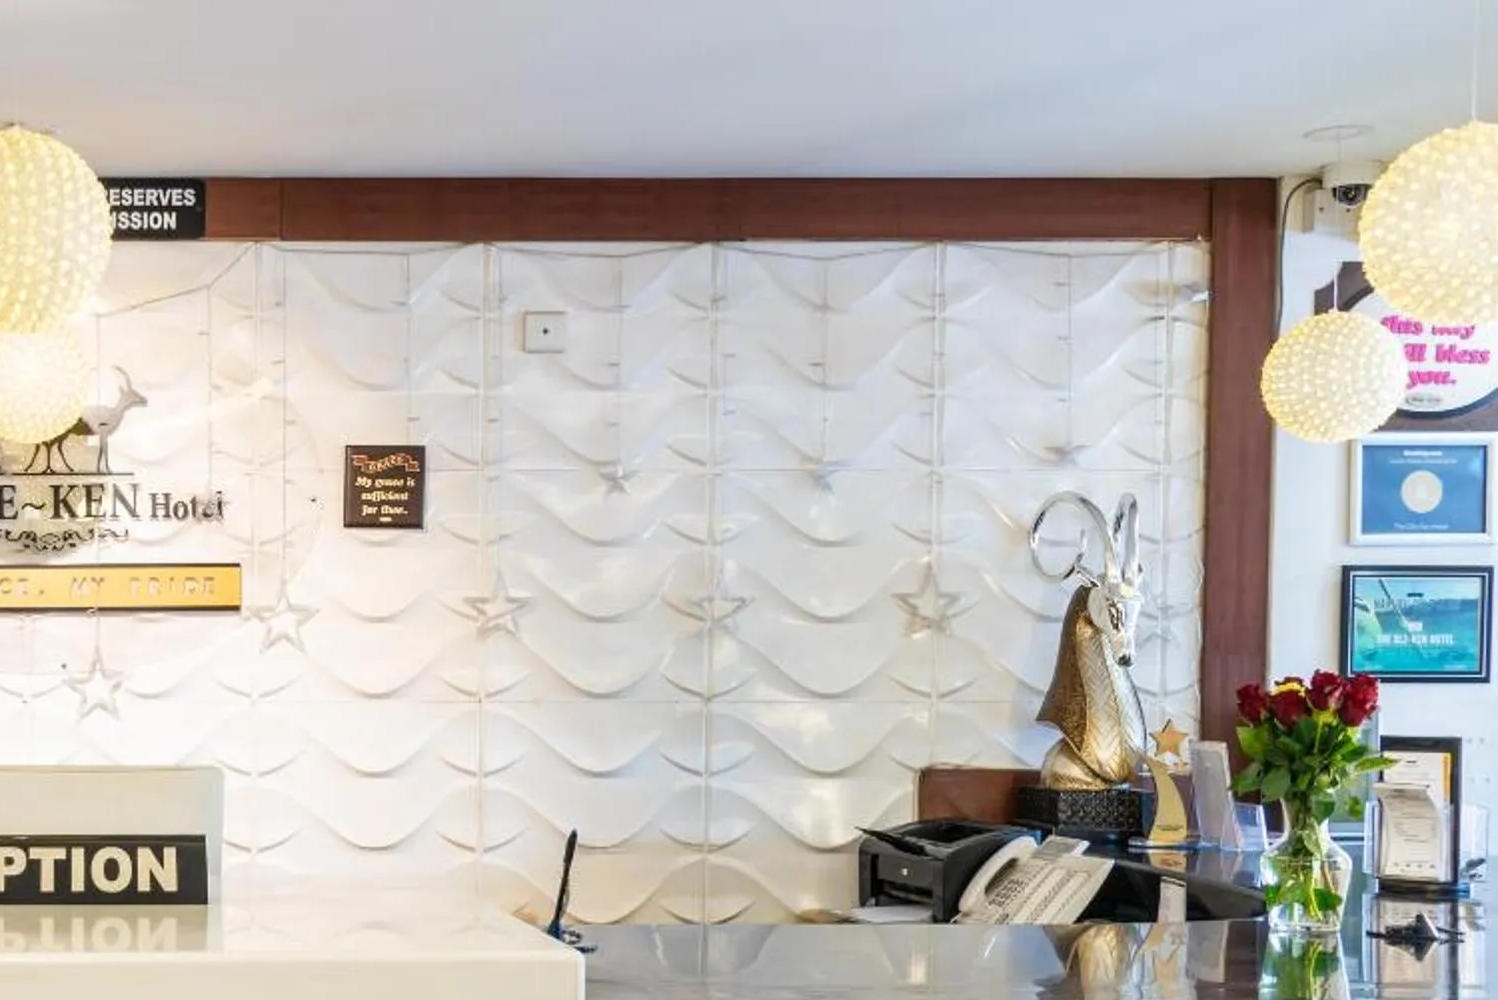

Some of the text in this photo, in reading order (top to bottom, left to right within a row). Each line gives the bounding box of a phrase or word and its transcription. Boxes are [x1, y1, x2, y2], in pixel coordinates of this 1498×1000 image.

[106, 188, 196, 207] ESERVES
[110, 211, 178, 231] ISSION
[1435, 343, 1491, 365] bless
